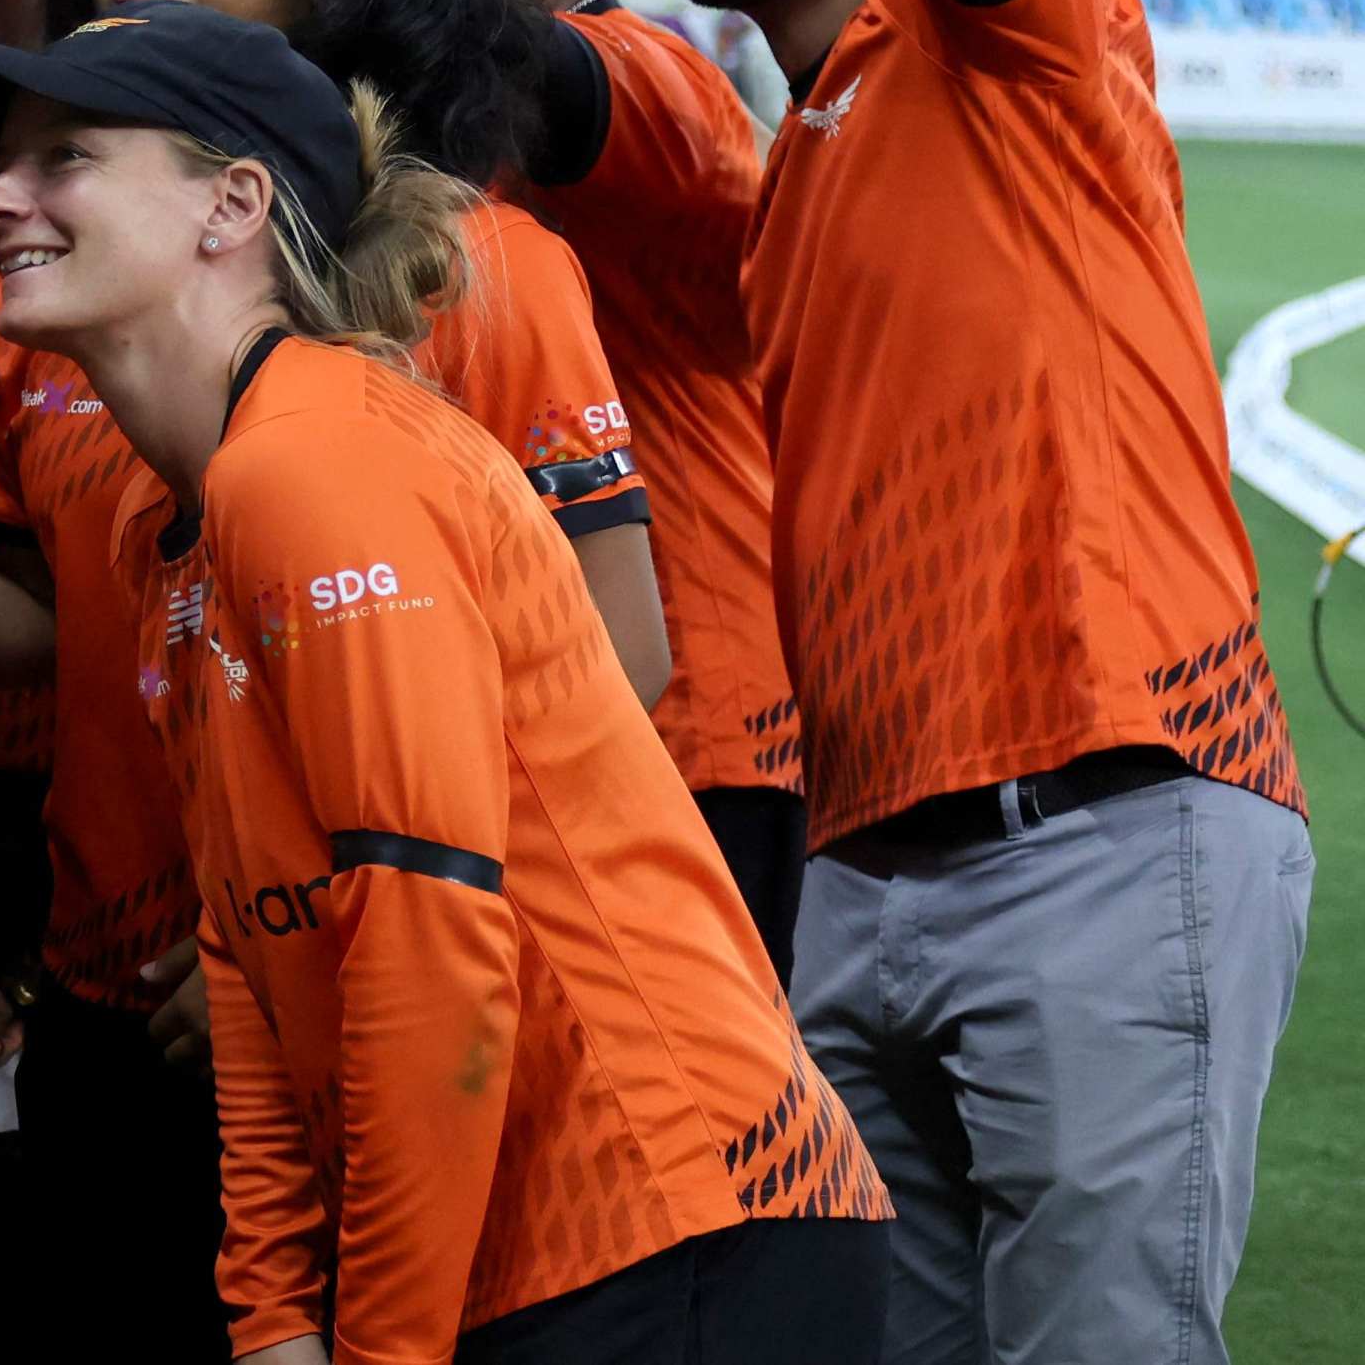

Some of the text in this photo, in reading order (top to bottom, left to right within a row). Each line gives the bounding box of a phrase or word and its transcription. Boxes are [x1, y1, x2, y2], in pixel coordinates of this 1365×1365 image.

[583, 401, 630, 435] SD
[310, 563, 399, 611] SDG
[316, 596, 435, 630] IMPACT FUND
